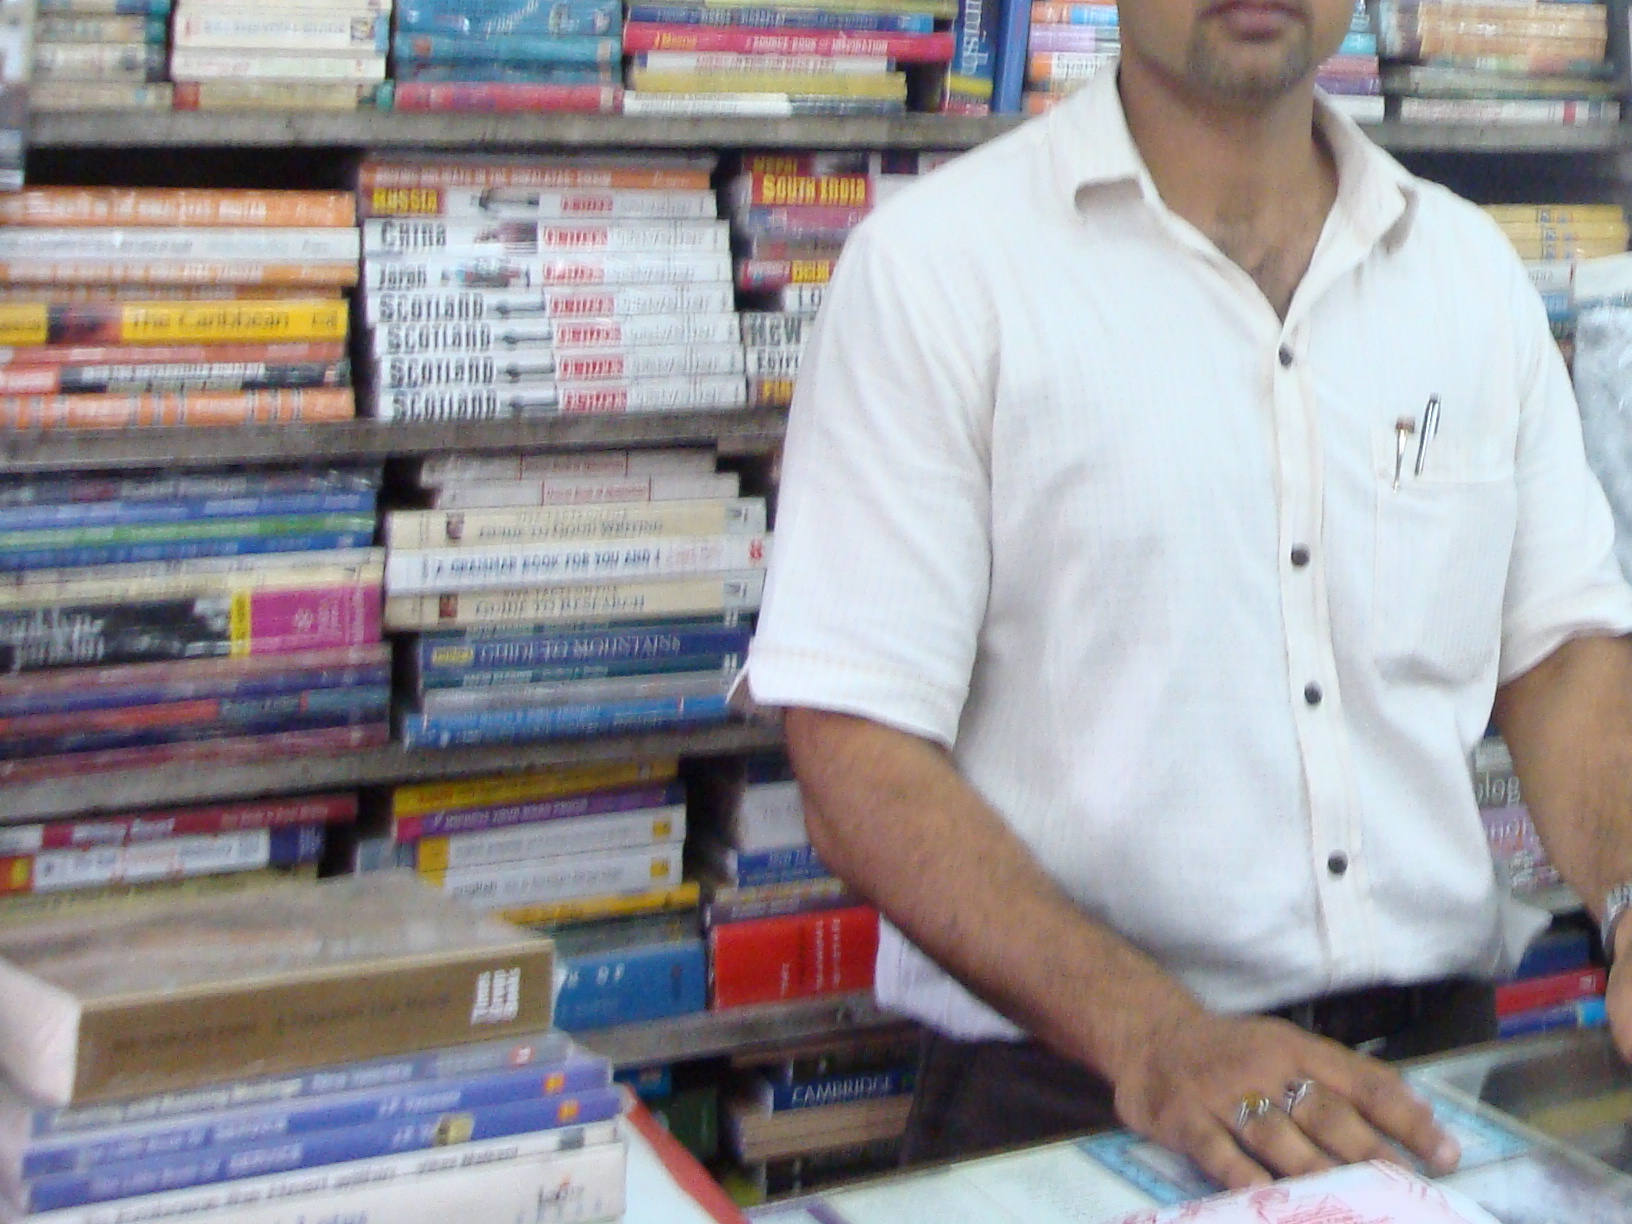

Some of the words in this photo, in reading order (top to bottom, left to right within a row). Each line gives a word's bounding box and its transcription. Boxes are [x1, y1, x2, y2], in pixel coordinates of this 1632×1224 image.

[450, 555, 517, 573] GRAMMAR
[522, 553, 558, 569] BOOK
[564, 552, 590, 567] FOR
[595, 551, 620, 566] YOU
[625, 550, 650, 565] AND
[792, 1075, 889, 1103] CAMBRIDGE
